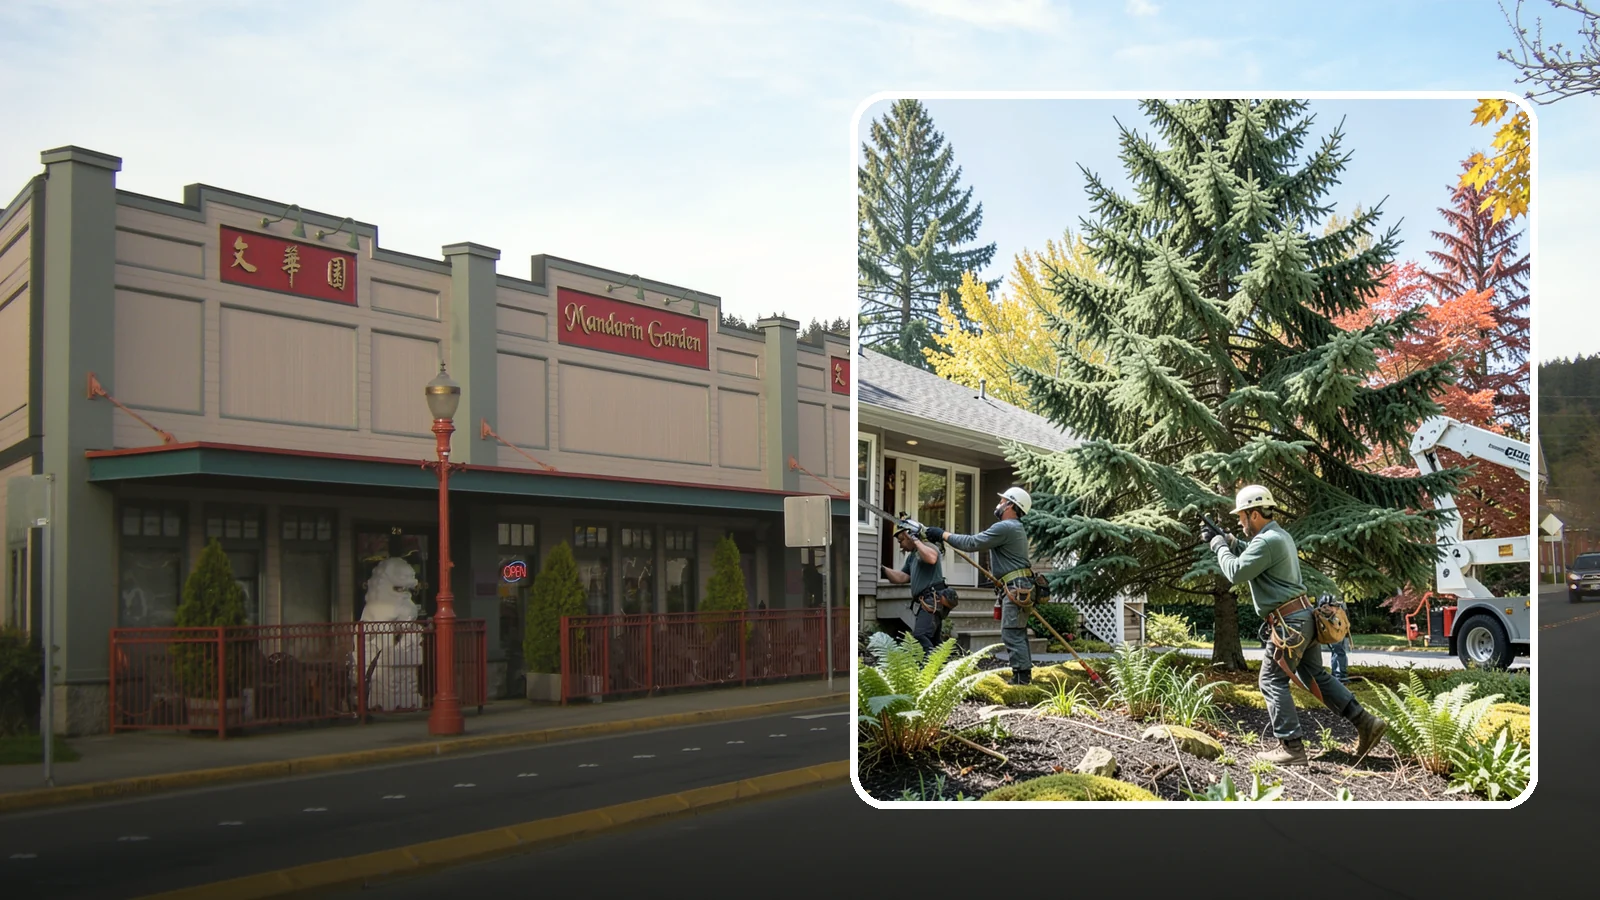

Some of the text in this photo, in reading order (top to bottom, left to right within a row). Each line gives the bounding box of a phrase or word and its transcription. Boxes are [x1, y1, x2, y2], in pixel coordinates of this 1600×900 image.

[231, 236, 346, 290] 文華園
[564, 303, 701, 352] Mandarin Garden
[503, 565, 527, 578] OPEN
